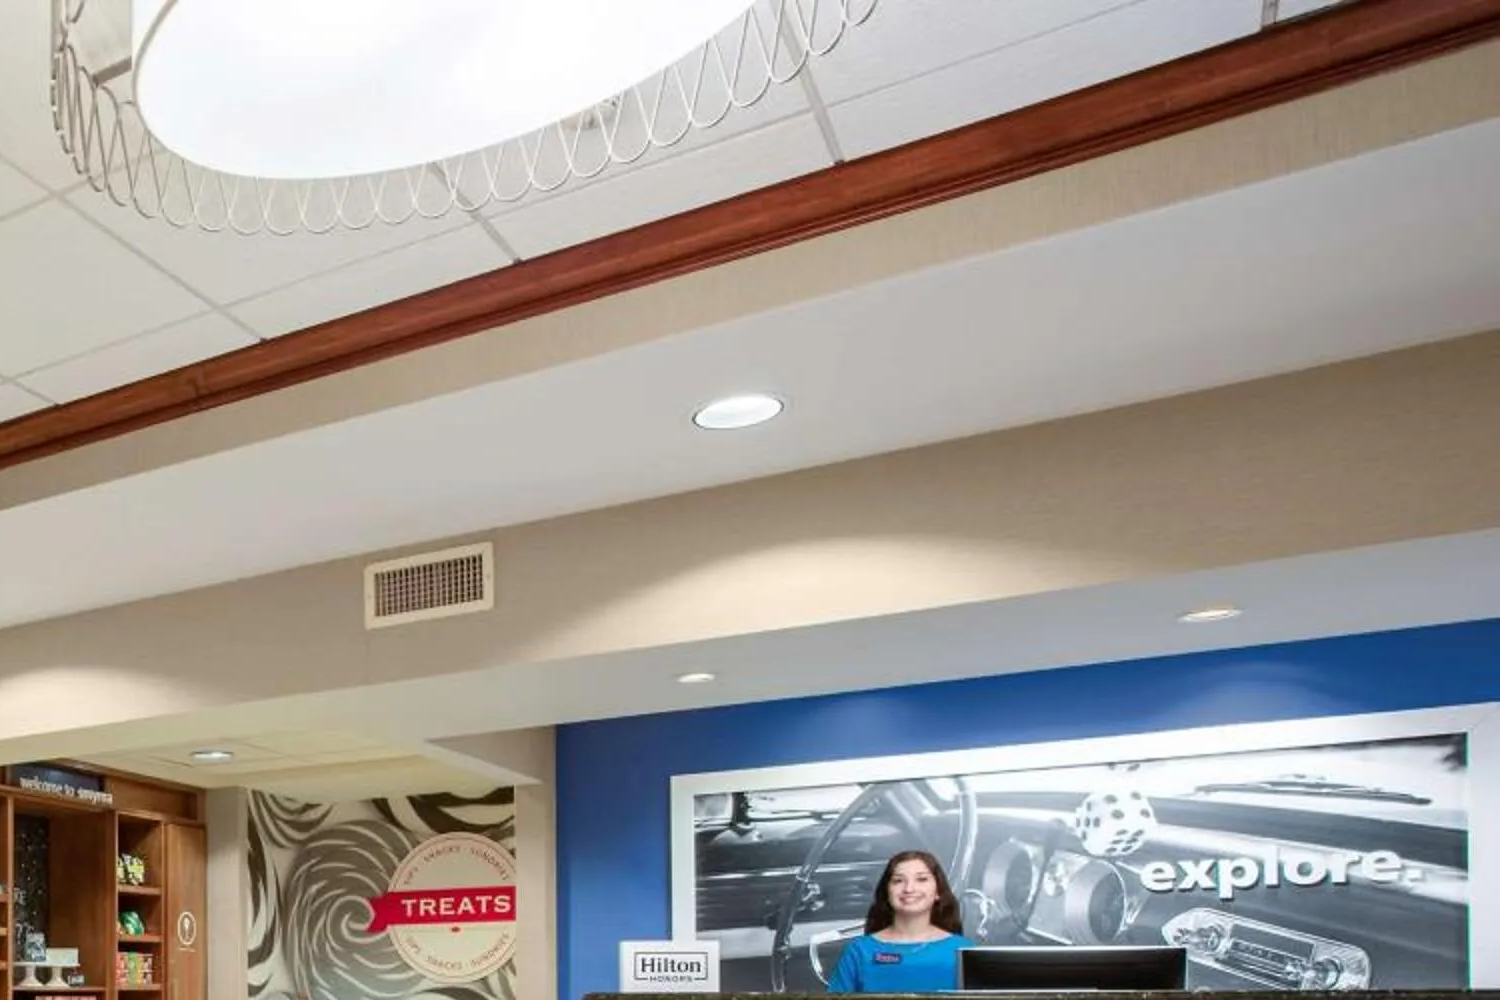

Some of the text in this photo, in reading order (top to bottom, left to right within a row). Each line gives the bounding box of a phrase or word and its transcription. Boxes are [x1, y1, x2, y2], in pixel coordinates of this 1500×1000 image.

[64, 784, 75, 797] to
[401, 895, 512, 918] TREATS
[641, 957, 702, 973] Hilton
[649, 975, 693, 983] HONORS
